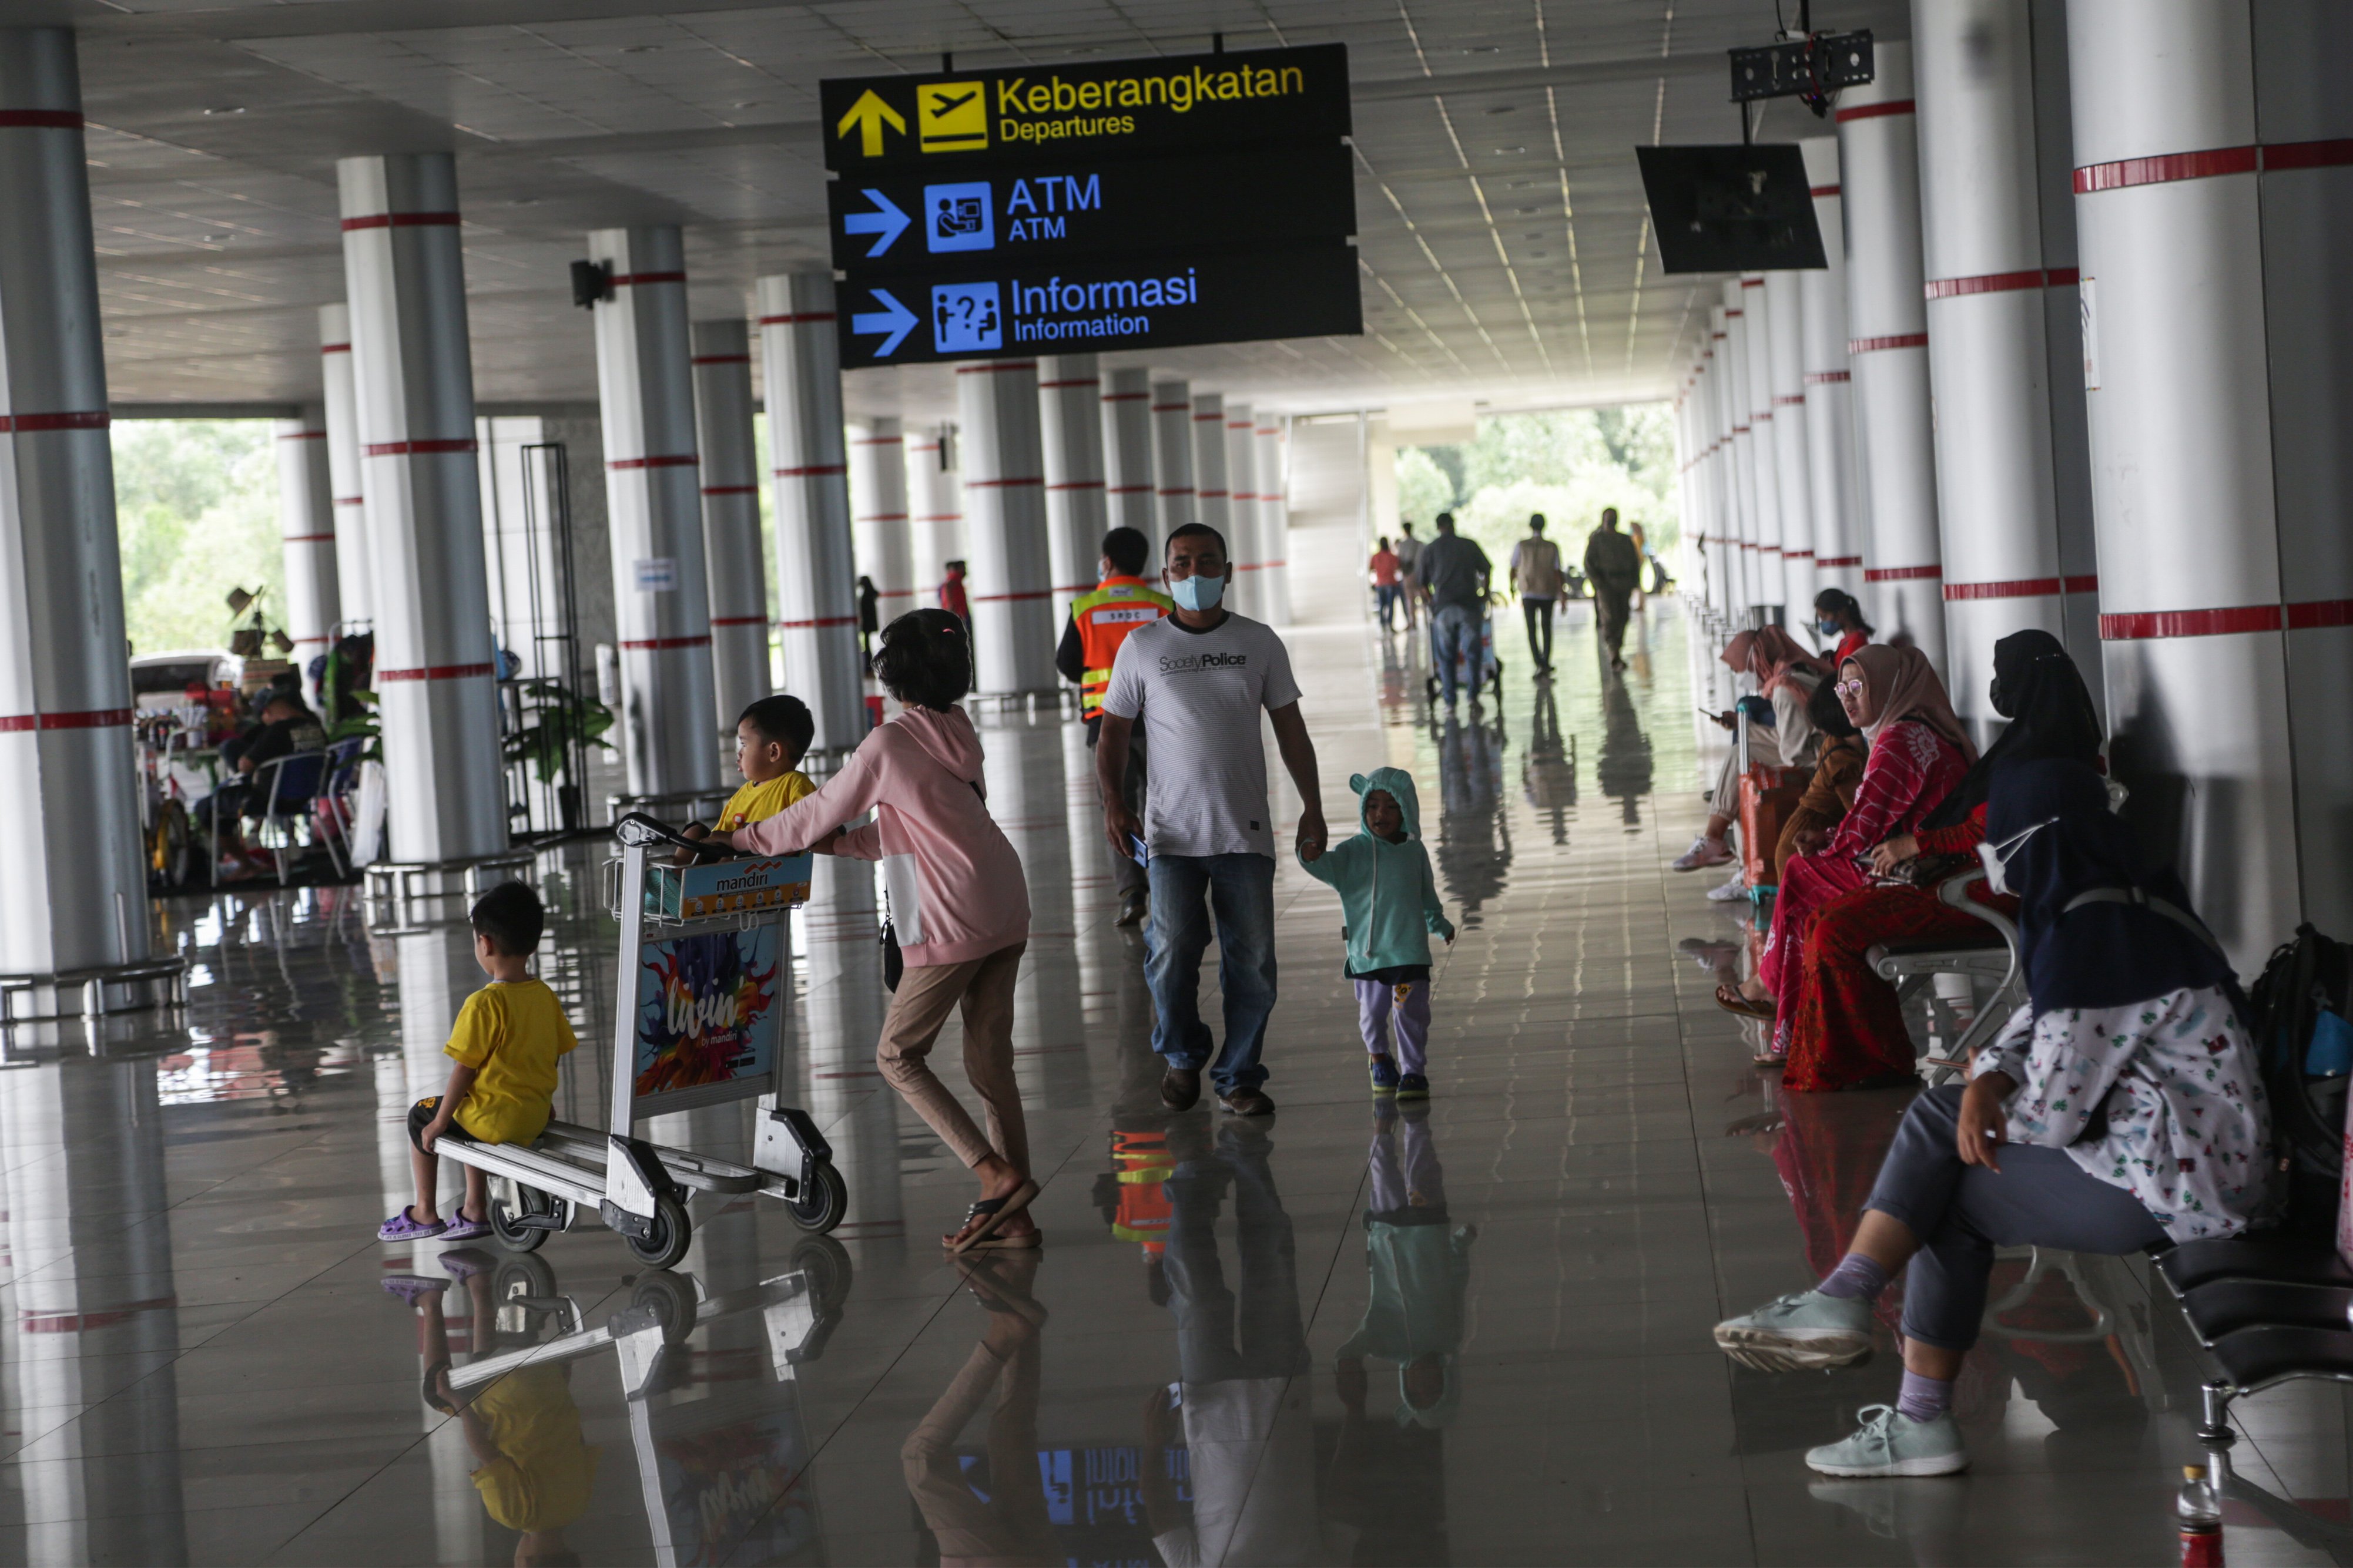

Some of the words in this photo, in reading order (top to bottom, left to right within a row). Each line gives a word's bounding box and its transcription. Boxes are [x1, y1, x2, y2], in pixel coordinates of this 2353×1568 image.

[998, 63, 1304, 115] Keberangkatan
[999, 115, 1135, 144] Departures
[1007, 173, 1102, 215] ATM
[1008, 216, 1067, 242] ATM
[1011, 268, 1198, 315] Informasi
[1014, 313, 1149, 341] Information
[716, 872, 767, 891] mandiri
[701, 1036, 709, 1048] by
[710, 1030, 738, 1045] mandiri
